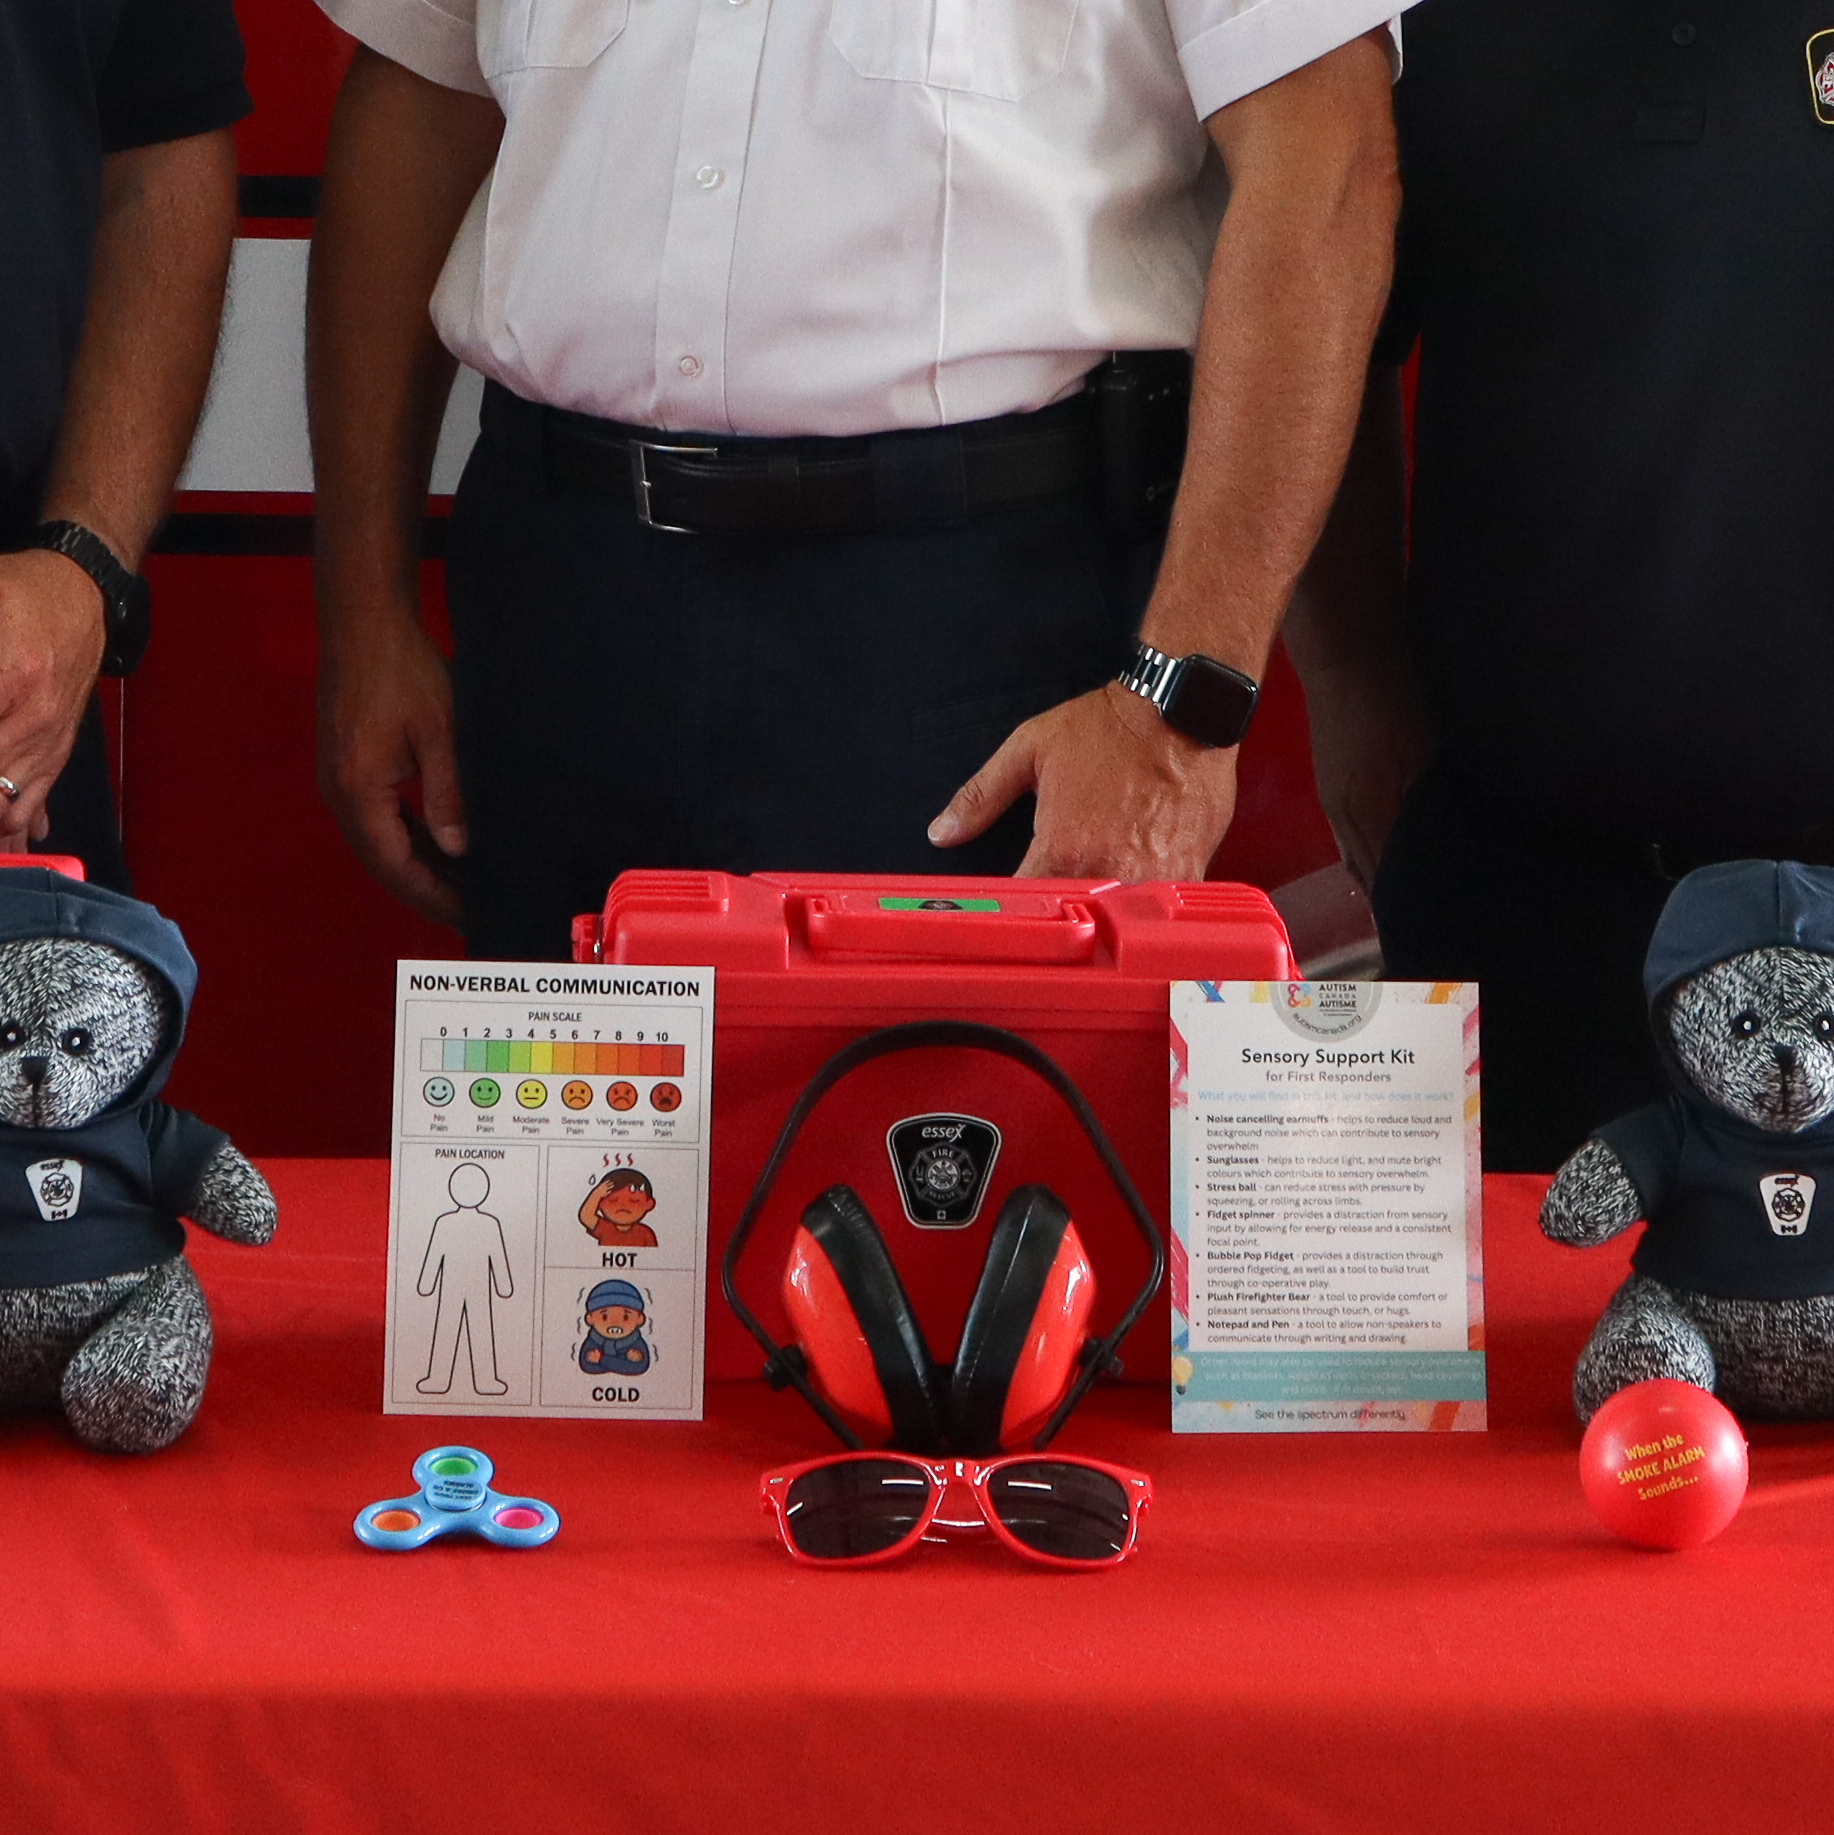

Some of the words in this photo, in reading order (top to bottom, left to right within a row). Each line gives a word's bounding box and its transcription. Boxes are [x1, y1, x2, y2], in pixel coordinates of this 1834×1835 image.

[410, 975, 531, 993] NON-VERBAL
[536, 978, 700, 997] COMMUNICATION
[1319, 984, 1357, 992] AUTISM
[1319, 1000, 1357, 1009] AUTISME
[528, 1011, 550, 1021] PAIN
[553, 1012, 582, 1022] SCALE
[440, 1027, 447, 1037] 0
[463, 1027, 468, 1037] 1
[483, 1028, 491, 1038] 2
[506, 1028, 513, 1038] 3
[527, 1029, 534, 1038] 4
[549, 1029, 557, 1039] 5
[571, 1030, 578, 1040] 6
[593, 1030, 601, 1040] 7
[615, 1031, 622, 1041] 8
[637, 1031, 644, 1041] 9
[656, 1032, 668, 1042] 10
[1242, 1048, 1309, 1067] Sensory
[1316, 1049, 1384, 1068] Support
[1391, 1049, 1415, 1064] Kit
[1266, 1071, 1283, 1082] for
[1287, 1072, 1315, 1082] First
[1319, 1072, 1391, 1084] Responders
[434, 1114, 445, 1122] No
[477, 1115, 494, 1123] Mild
[513, 1116, 550, 1125] Moderate
[562, 1117, 589, 1126] Severe
[597, 1118, 614, 1128] Very
[617, 1119, 645, 1127] Severe
[652, 1119, 675, 1127] Worst
[1207, 1115, 1233, 1123] Noise
[1236, 1115, 1284, 1125] cancelling
[1286, 1115, 1328, 1123] earmuffs
[1365, 1116, 1374, 1124] to
[1377, 1116, 1409, 1124] reduce
[1411, 1116, 1432, 1124] loud
[430, 1124, 448, 1133] Pain
[476, 1124, 495, 1133] Pain
[522, 1125, 540, 1134] Pain
[566, 1127, 584, 1135] Pain
[611, 1128, 629, 1136] Pain
[654, 1129, 673, 1138] Pain
[921, 1124, 966, 1143] essex
[435, 1148, 457, 1160] PAIN
[459, 1149, 505, 1160] LOCATION
[932, 1148, 954, 1158] FIRE
[1207, 1156, 1259, 1166] Sunglasses
[1267, 1156, 1292, 1165] helps
[1308, 1156, 1339, 1164] reduce
[1368, 1156, 1385, 1164] and
[1414, 1157, 1441, 1166] bright
[1207, 1183, 1236, 1191] Stress
[1239, 1183, 1256, 1191] ball
[1207, 1210, 1236, 1220] Fidget
[1239, 1211, 1274, 1220] spinner
[1284, 1211, 1323, 1220] provides
[1334, 1211, 1384, 1219] distraction
[1387, 1210, 1409, 1219] from
[1412, 1212, 1448, 1221] sensory
[1208, 1225, 1231, 1233] input
[1235, 1225, 1245, 1234] by
[1249, 1225, 1287, 1234] allowing
[1289, 1224, 1302, 1232] for
[1305, 1226, 1336, 1234] energy
[1403, 1225, 1452, 1233] consistent
[602, 1253, 637, 1267] HOT
[1244, 1252, 1261, 1261] Pop
[1265, 1252, 1293, 1261] Fidget
[1302, 1252, 1342, 1261] provides
[1353, 1252, 1403, 1260] distraction
[1406, 1252, 1443, 1262] through
[1208, 1293, 1233, 1301] Plush
[1236, 1293, 1285, 1303] Firefighter
[1208, 1321, 1249, 1330] Notepad
[1252, 1320, 1269, 1328] and
[1208, 1335, 1272, 1343] communicate
[1274, 1334, 1311, 1344] through
[1314, 1335, 1346, 1344] writing
[592, 1387, 639, 1403] COLD
[1255, 1410, 1274, 1419] See
[1277, 1410, 1295, 1419] the
[1297, 1411, 1348, 1421] spectrum
[1625, 1442, 1661, 1461] When
[1662, 1434, 1684, 1449] the
[1617, 1461, 1661, 1485] SMOKE
[1664, 1446, 1706, 1472] ALARM
[1638, 1476, 1699, 1501] Sounds...
